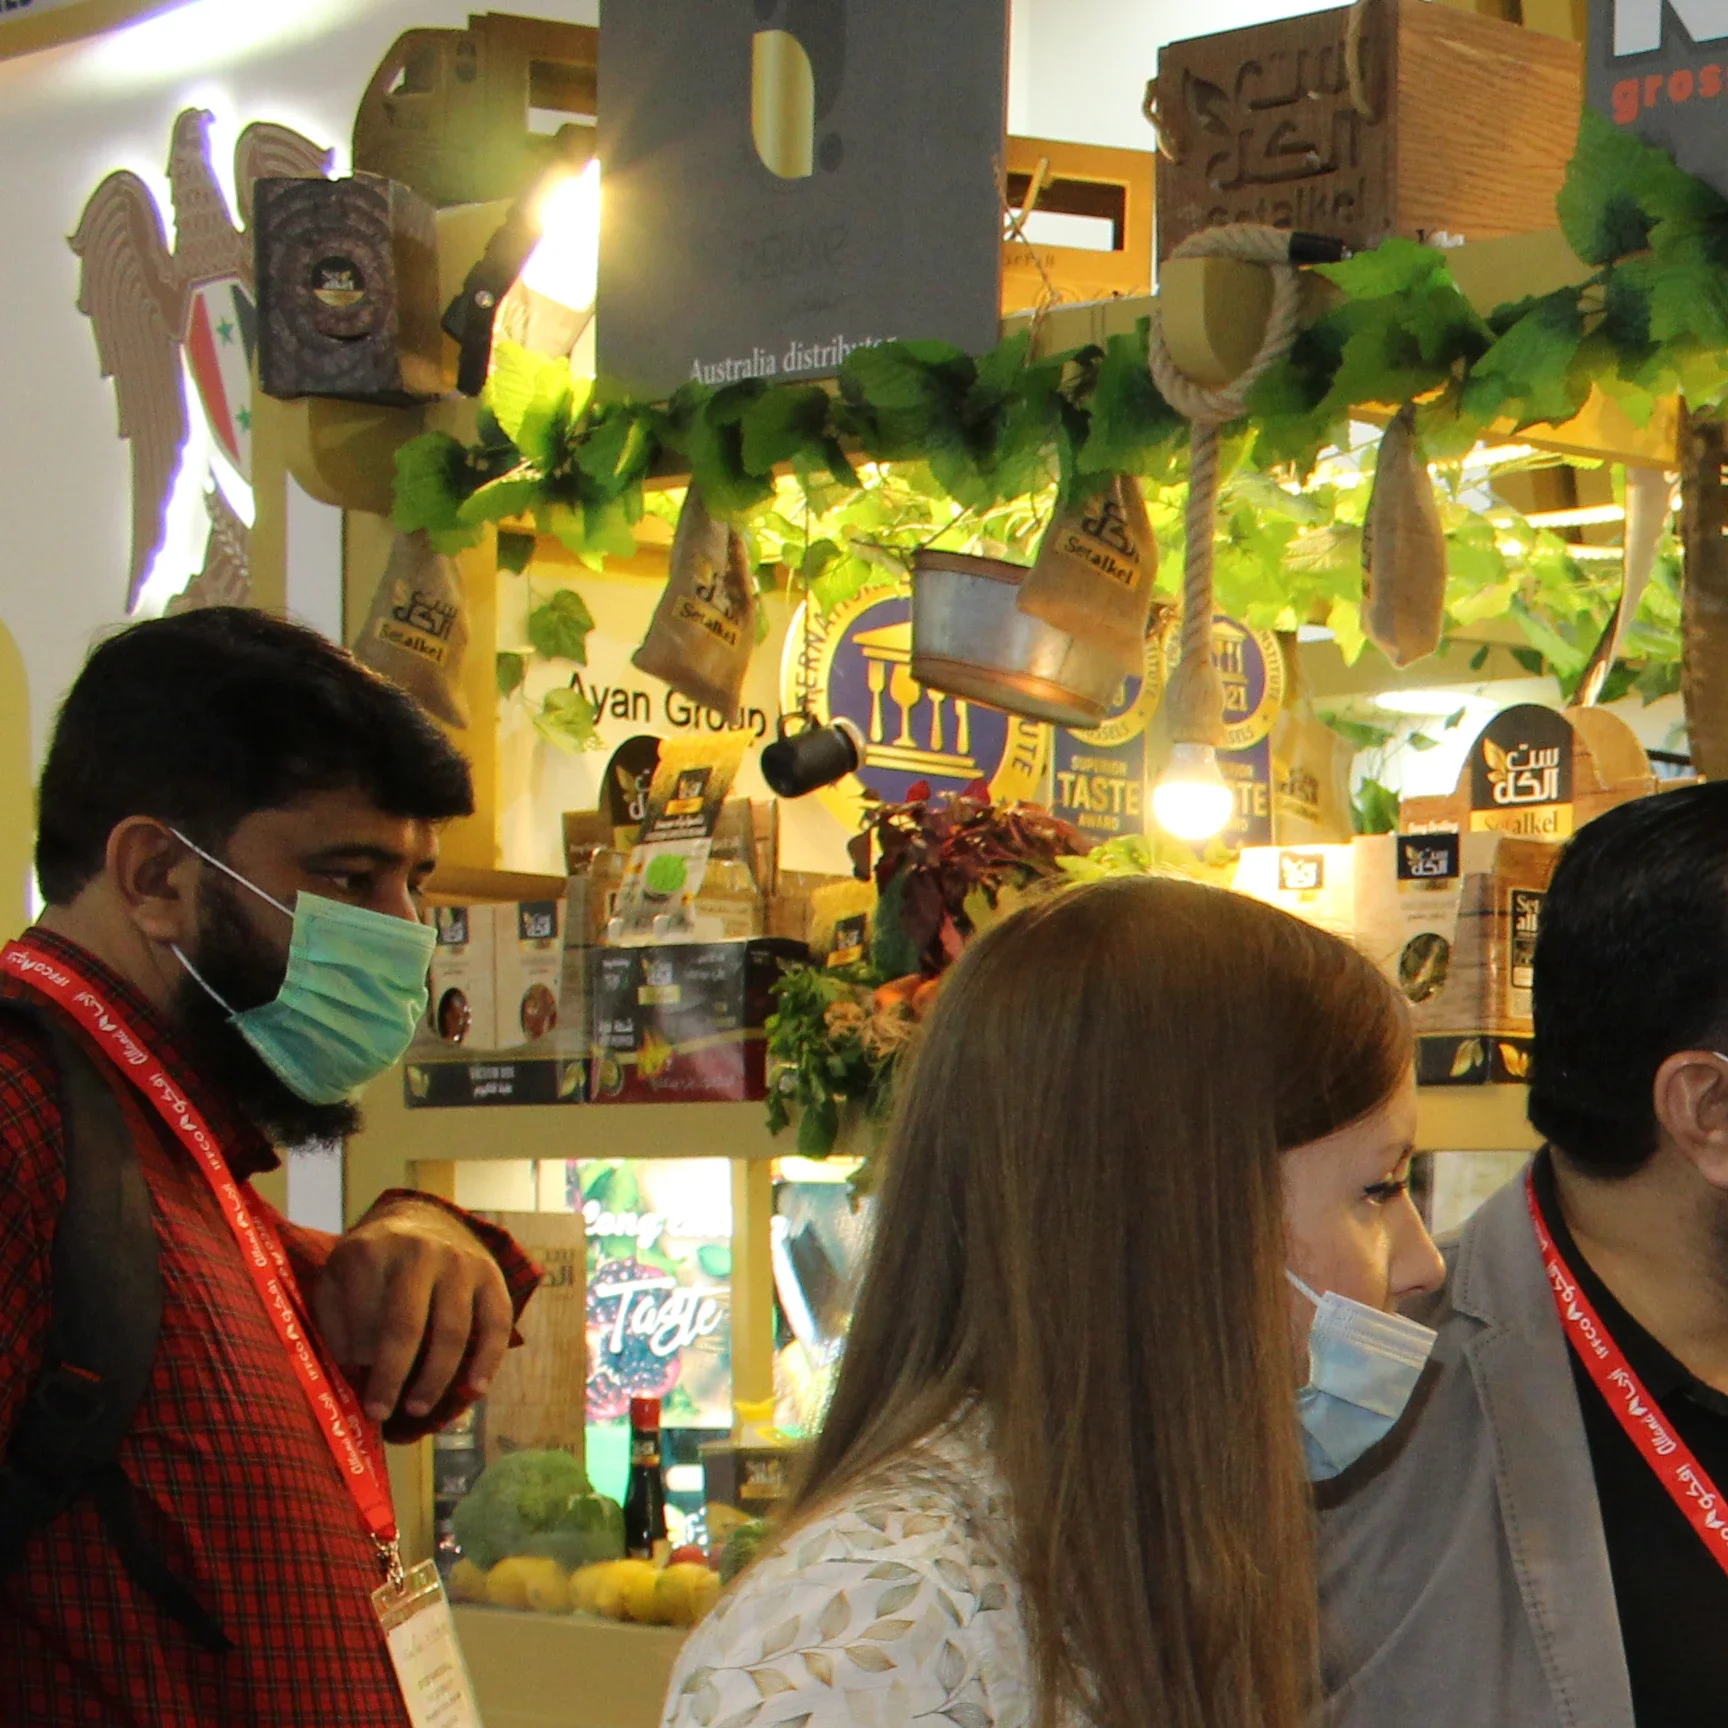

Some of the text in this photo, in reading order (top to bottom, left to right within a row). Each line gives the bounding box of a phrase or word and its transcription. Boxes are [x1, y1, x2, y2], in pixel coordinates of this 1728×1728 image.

[690, 345, 776, 385] Australia
[1506, 743, 1560, 772] ست
[1057, 772, 1142, 817] TASTE
[1493, 769, 1560, 804] الكل
[594, 1277, 723, 1358] Taste
[1579, 1316, 1609, 1361] IFFCO
